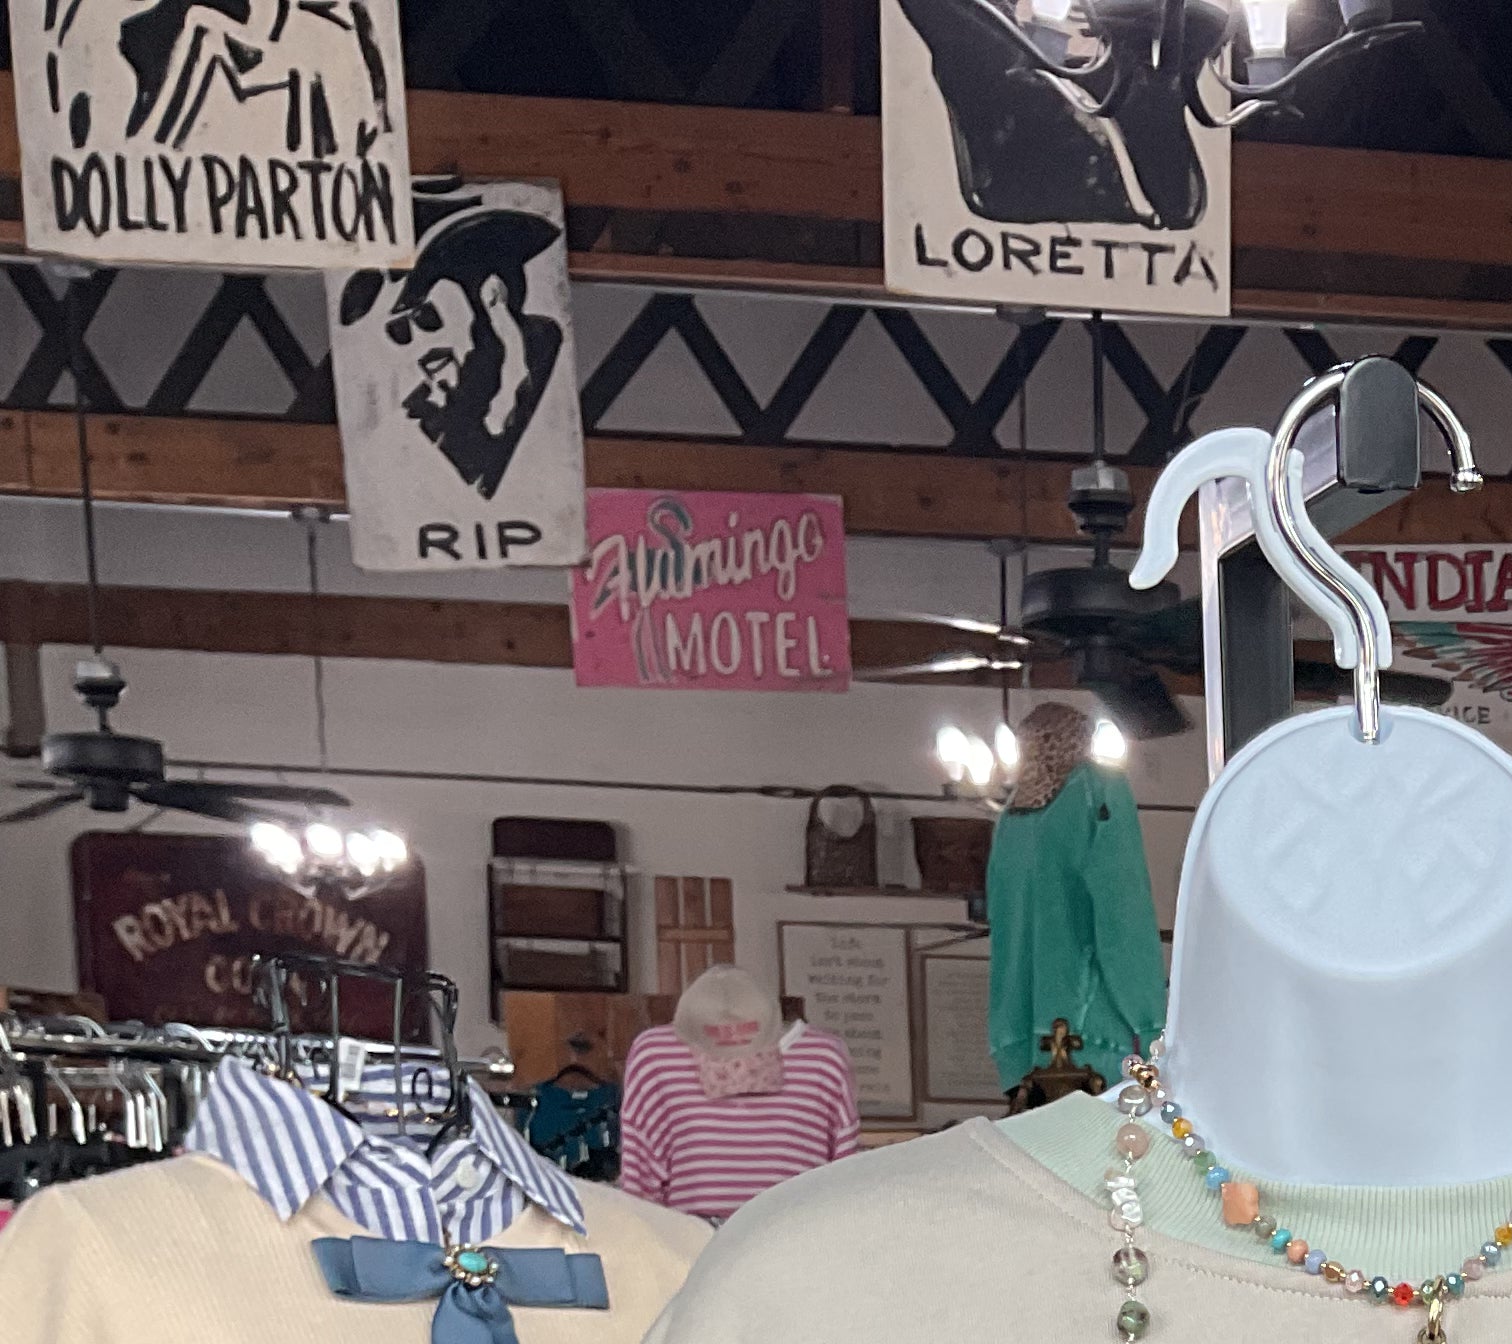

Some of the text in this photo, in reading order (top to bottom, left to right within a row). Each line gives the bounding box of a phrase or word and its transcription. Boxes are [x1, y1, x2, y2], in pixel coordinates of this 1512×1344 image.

[50, 152, 397, 244] DOLLY PARTON
[914, 222, 1220, 292] LORETTA
[418, 521, 542, 560] RIP
[585, 511, 823, 622] Flamingo
[665, 611, 833, 678] MOTEL
[111, 888, 391, 964] ROYAL CROWN
